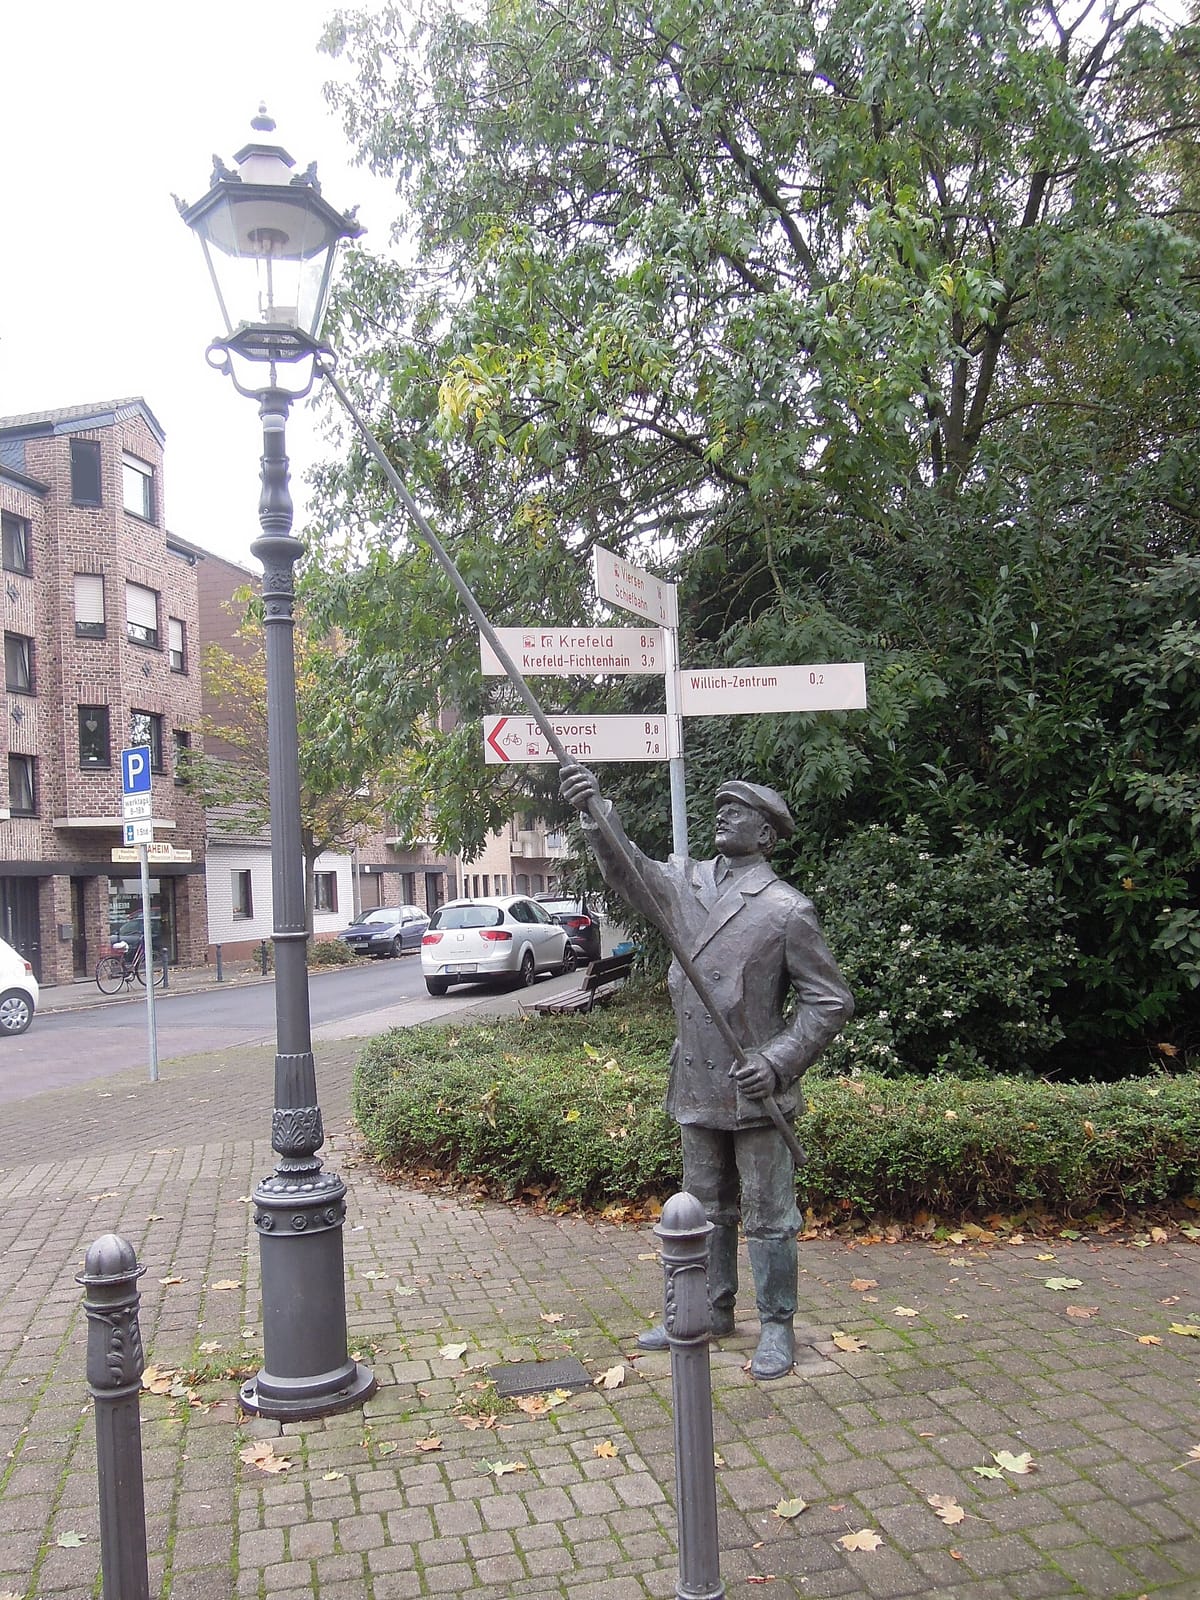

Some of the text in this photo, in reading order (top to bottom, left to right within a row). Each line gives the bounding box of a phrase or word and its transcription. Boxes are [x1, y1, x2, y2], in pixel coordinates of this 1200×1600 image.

[559, 635, 613, 648] Krefeld
[640, 635, 655, 649] 8,5
[522, 654, 655, 668] Krefeld-Fichtenhain 3,9
[691, 672, 824, 690] Willich-Zentrum 0,2
[526, 722, 659, 736] Töisvorst 8,8
[545, 741, 660, 755] Arath 7,8
[128, 753, 144, 788] P
[147, 844, 170, 854] AHEIM
